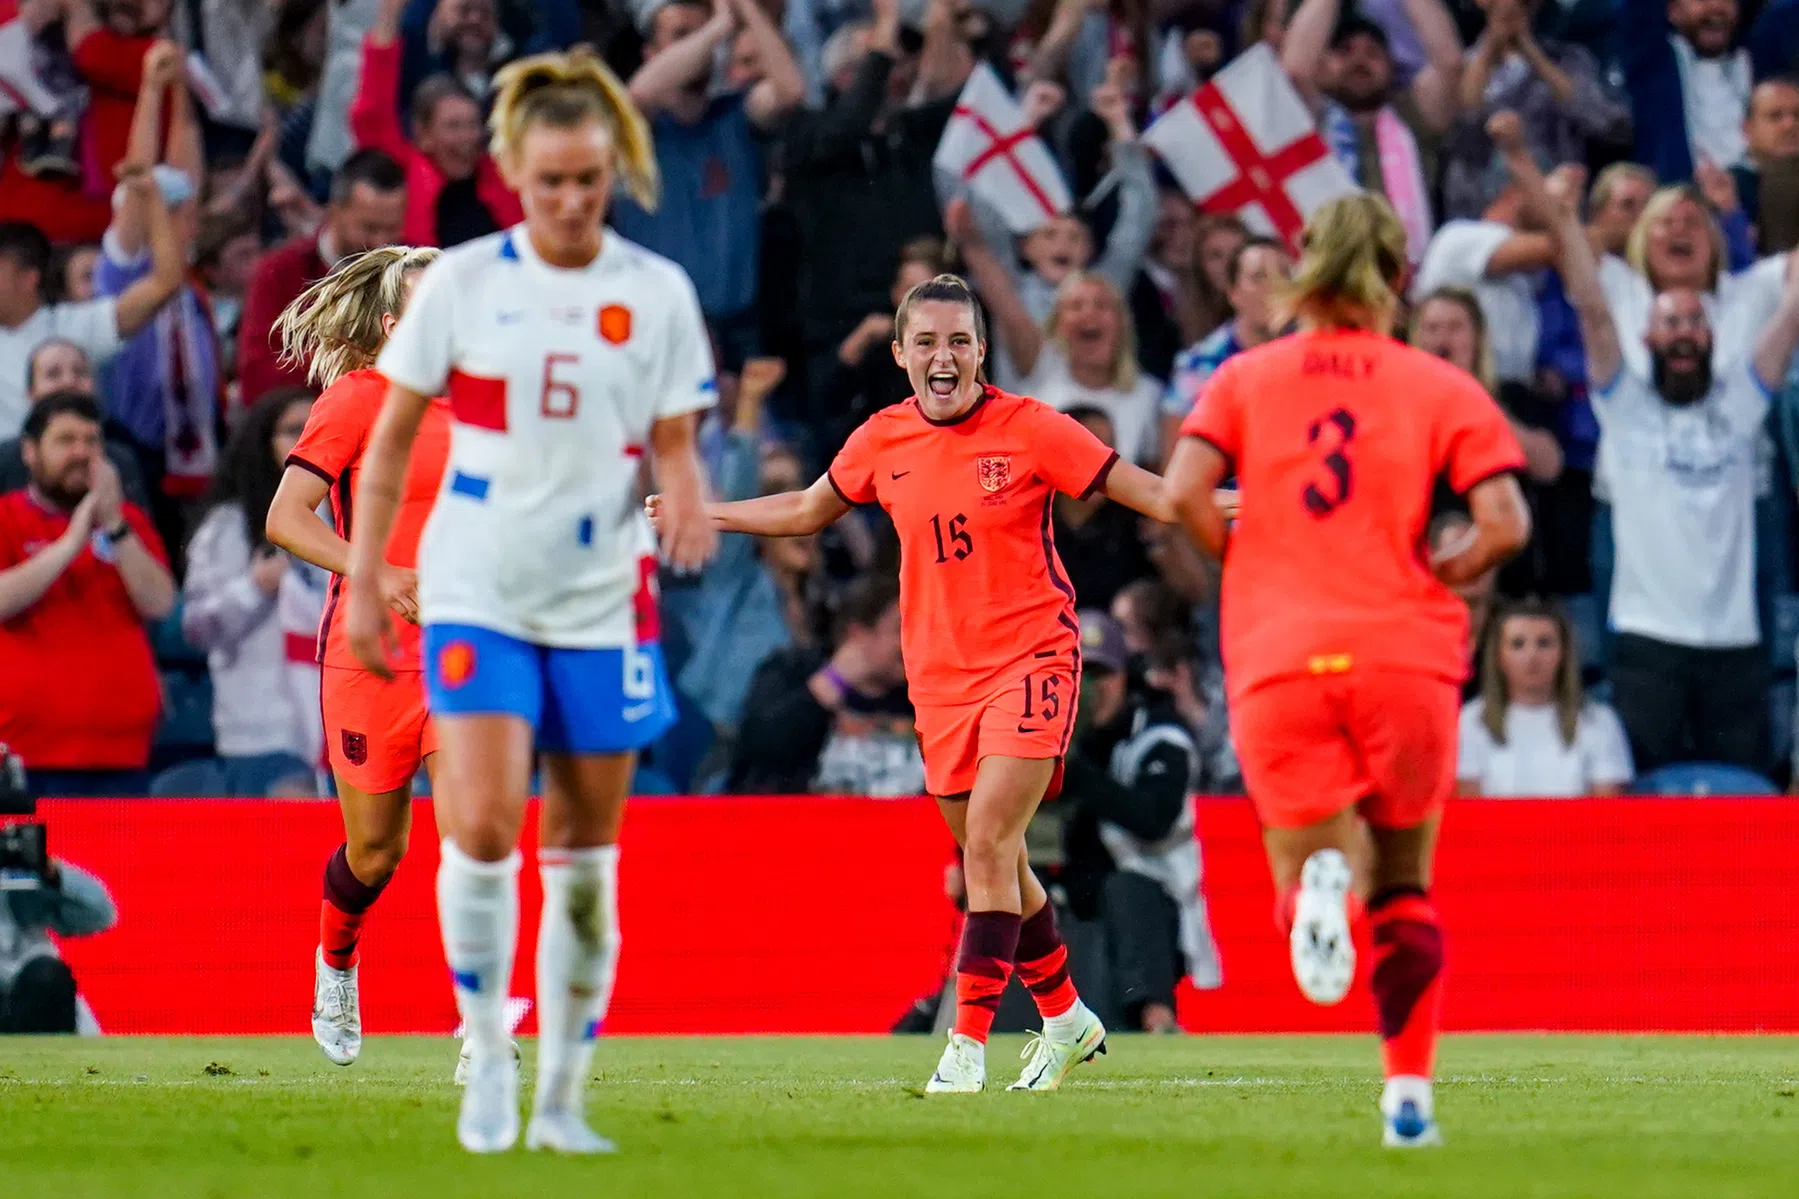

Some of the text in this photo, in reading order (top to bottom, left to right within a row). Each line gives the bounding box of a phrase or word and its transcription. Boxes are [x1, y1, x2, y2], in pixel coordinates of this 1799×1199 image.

[541, 353, 580, 418] 6
[1304, 409, 1355, 515] 3
[929, 512, 973, 563] 15
[623, 645, 654, 699] 6
[1020, 673, 1060, 721] 15
